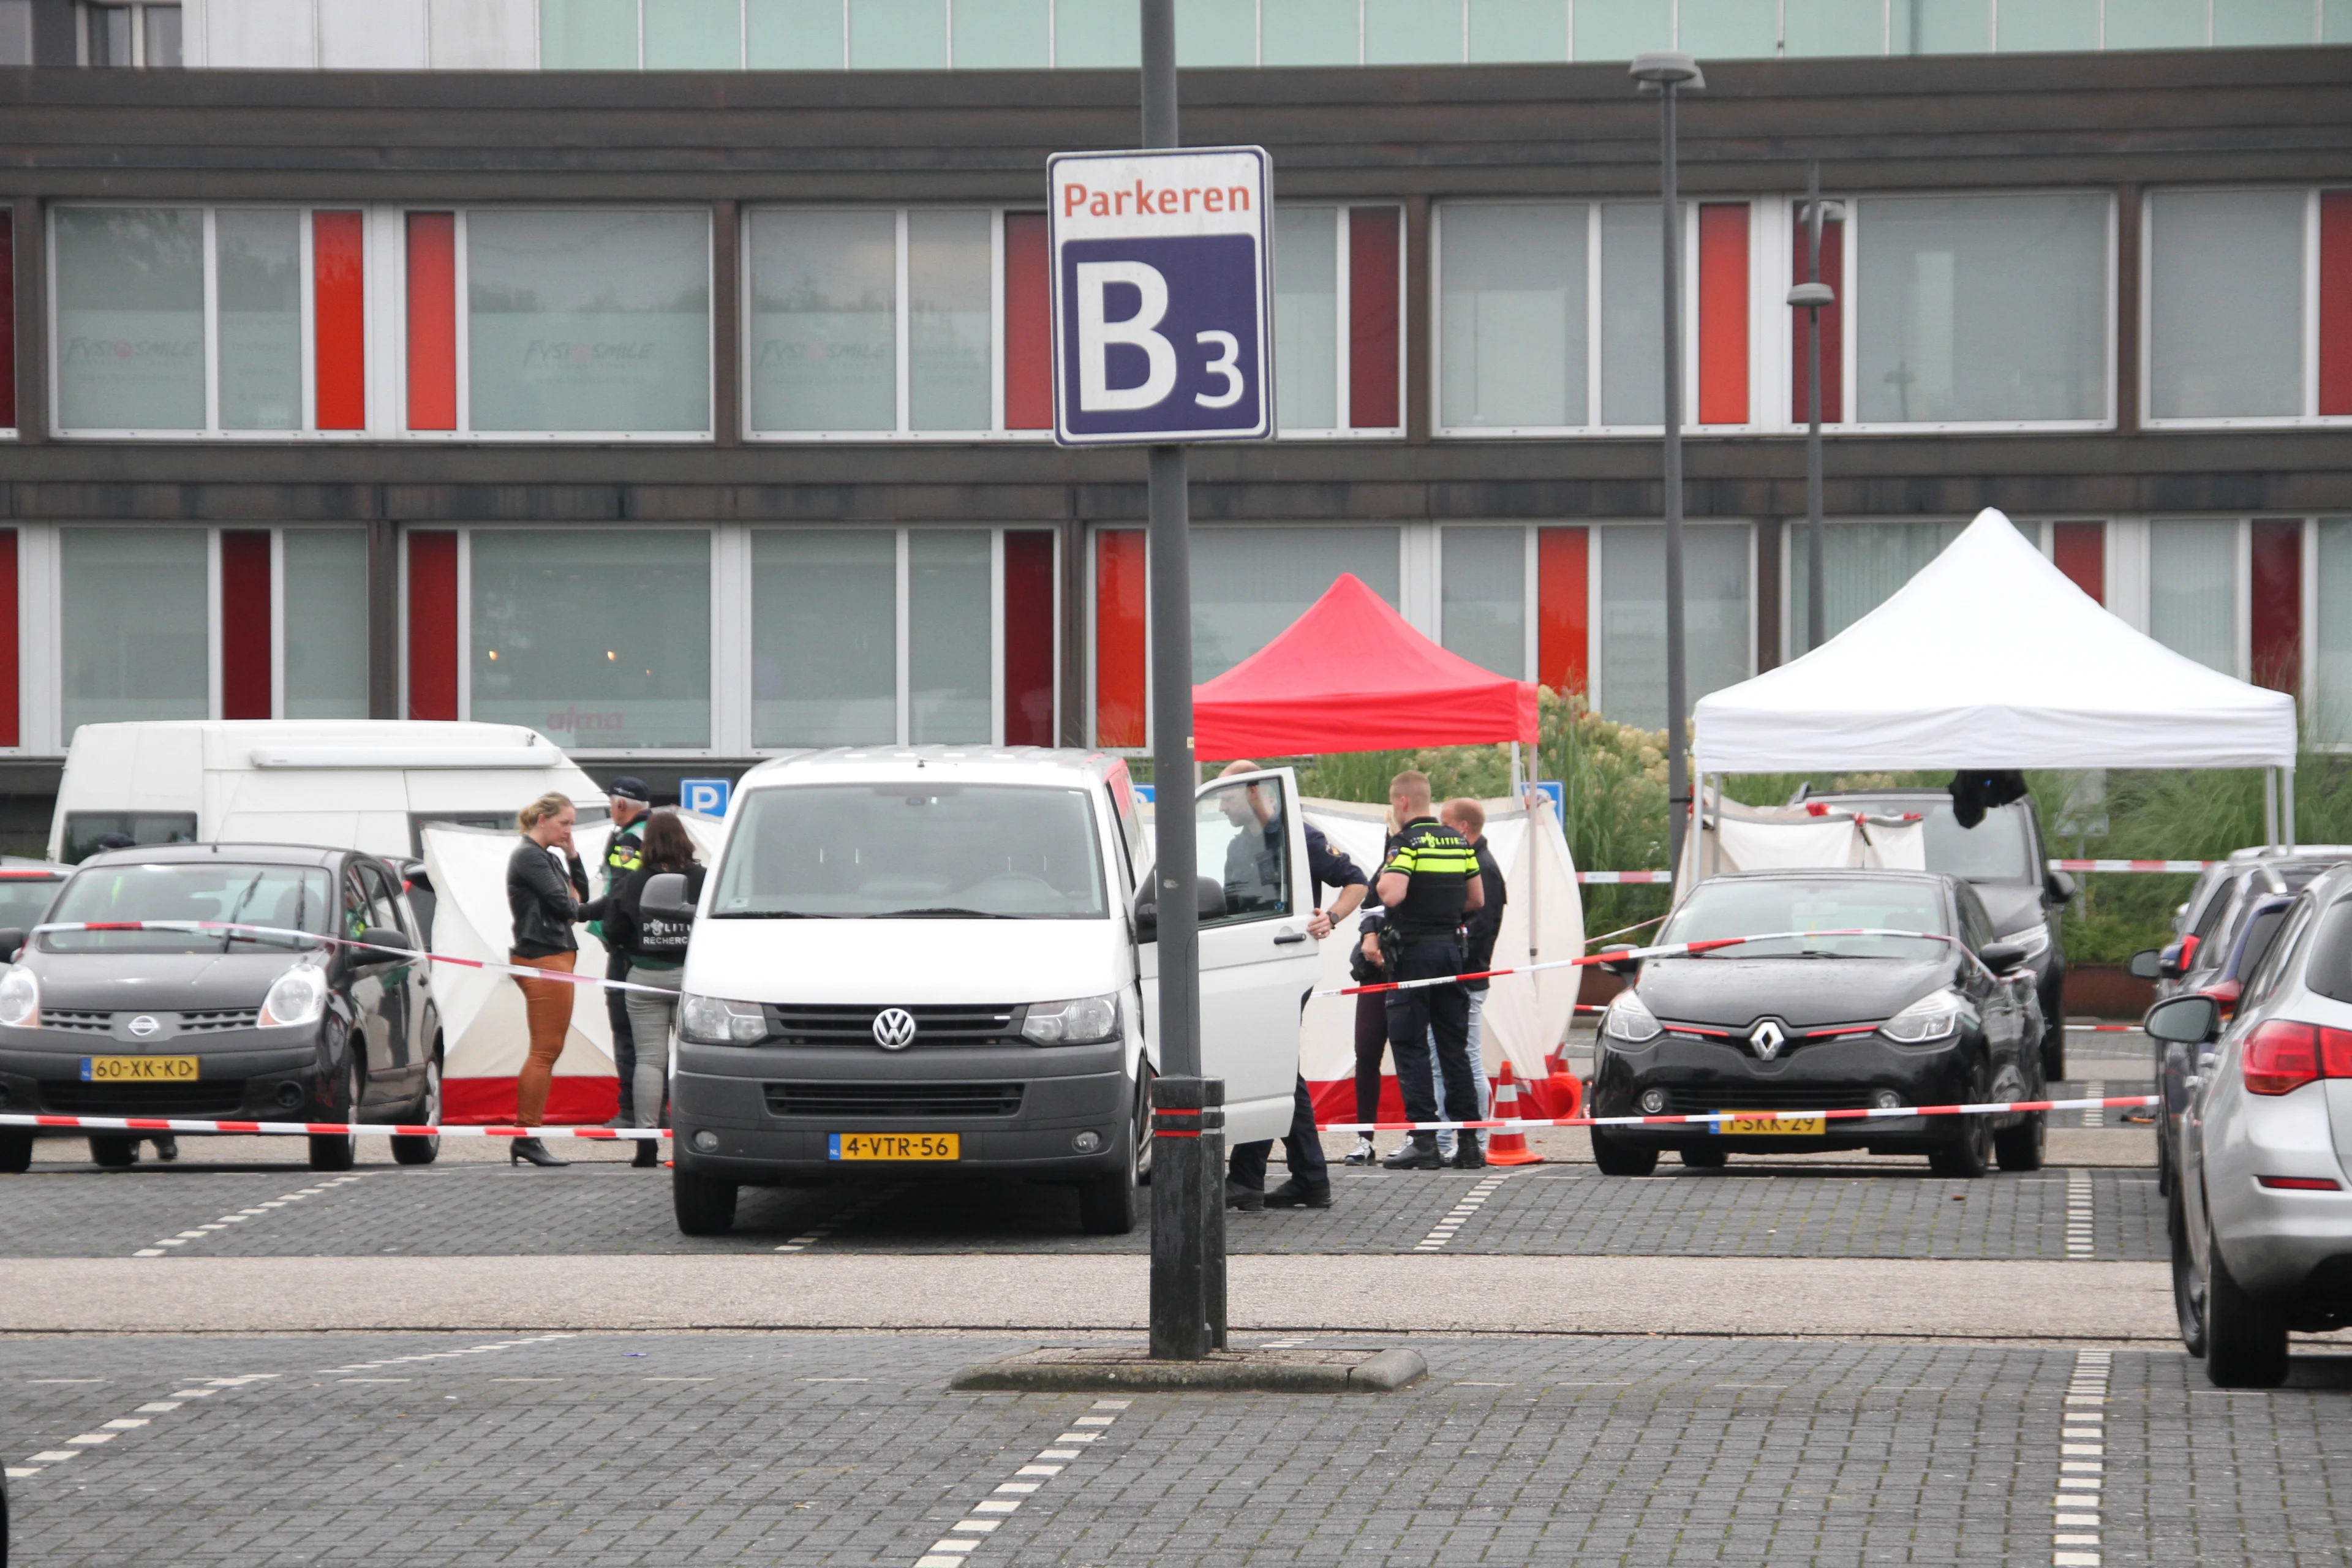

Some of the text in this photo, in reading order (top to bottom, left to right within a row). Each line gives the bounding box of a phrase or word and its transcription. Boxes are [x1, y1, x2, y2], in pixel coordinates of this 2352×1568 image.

[1064, 179, 1250, 217] Parkeren
[1076, 260, 1244, 412] B 3
[693, 786, 718, 812] P
[96, 1060, 192, 1077] 60-XK-KD
[846, 1137, 949, 1156] 4-VTR-56
